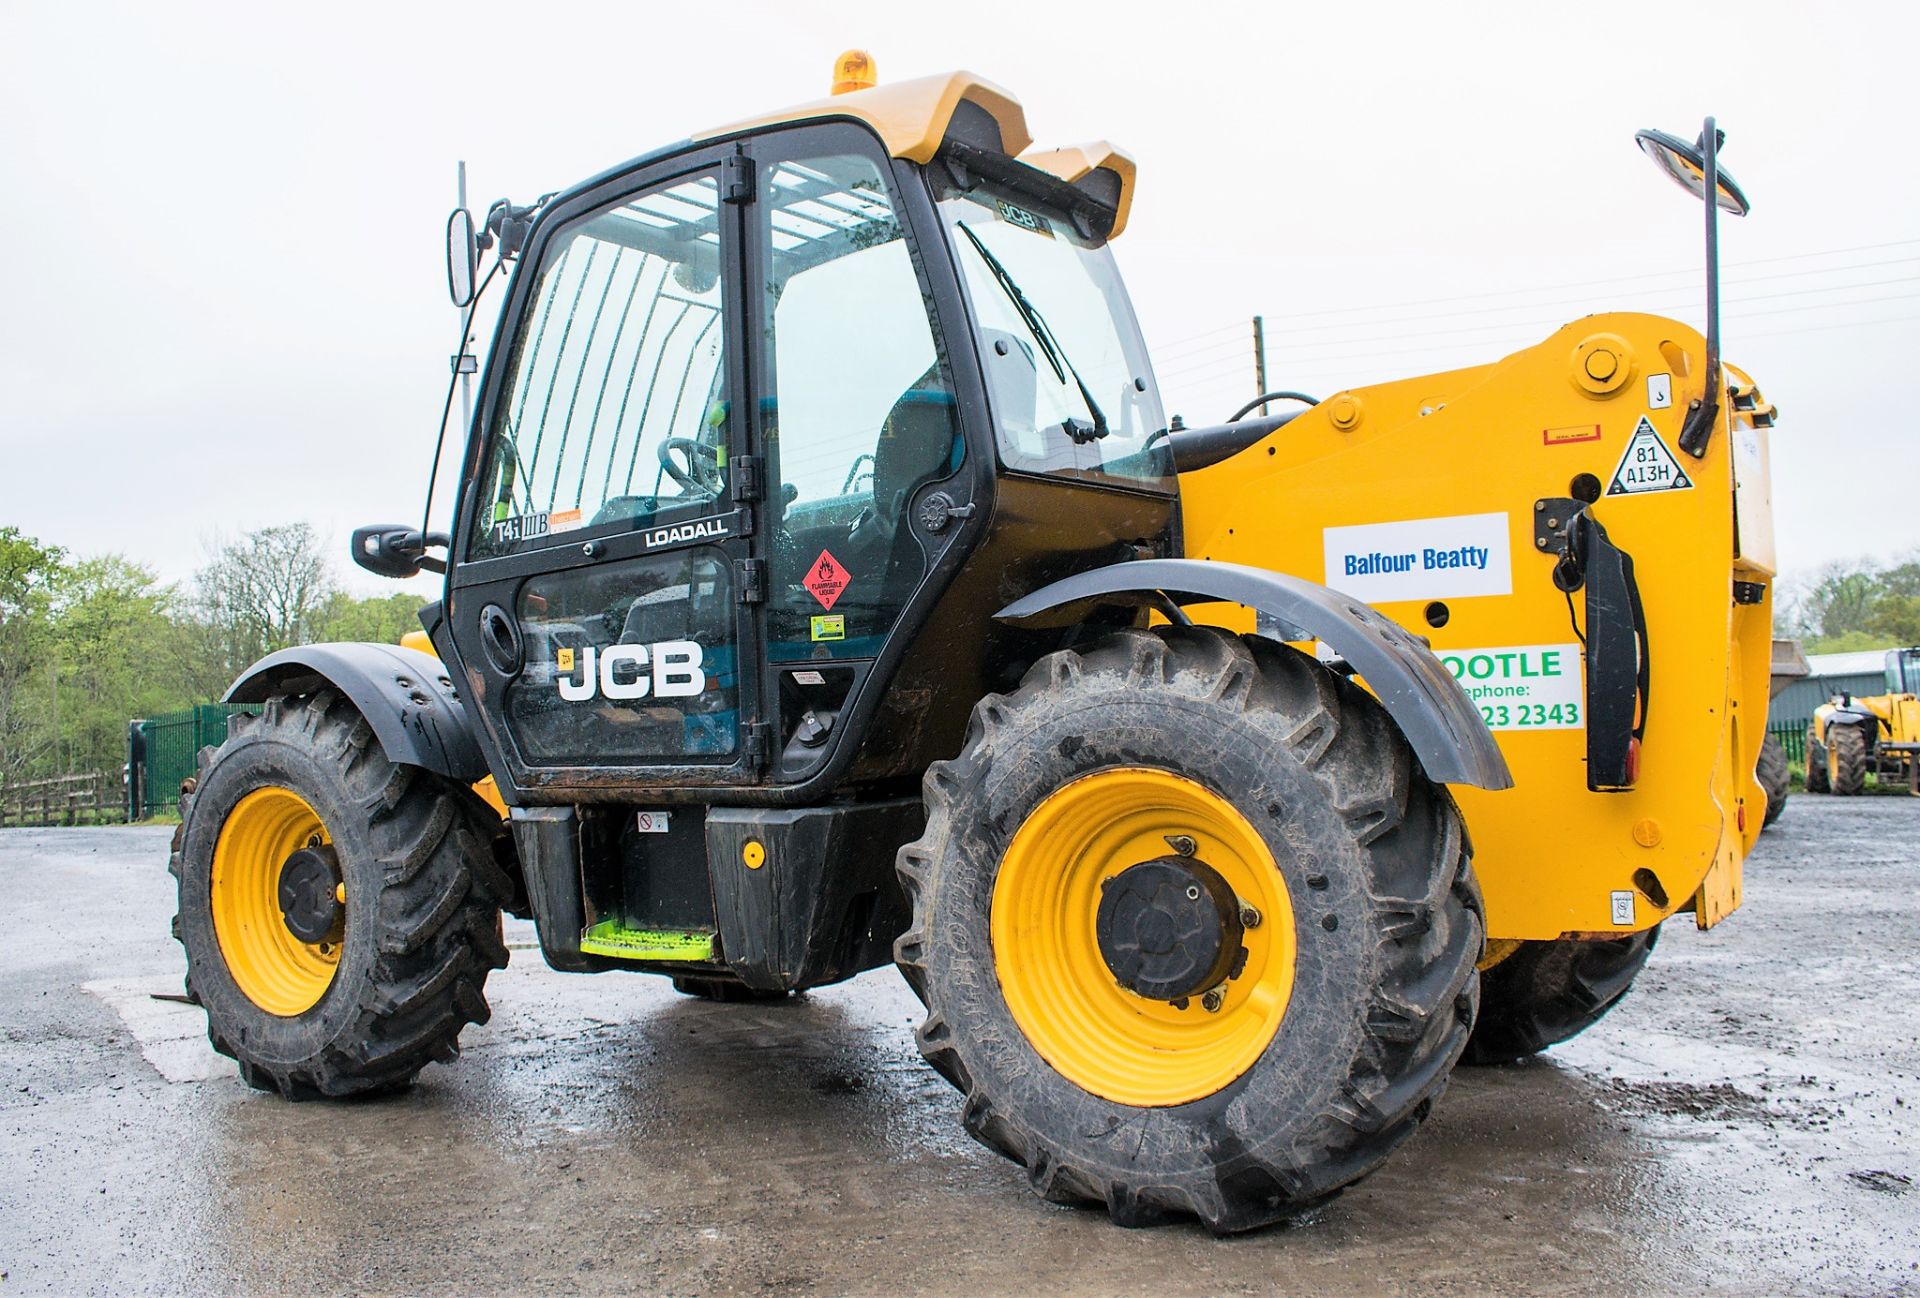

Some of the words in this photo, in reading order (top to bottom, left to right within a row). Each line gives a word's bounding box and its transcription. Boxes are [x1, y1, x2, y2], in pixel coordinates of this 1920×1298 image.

[1001, 203, 1036, 228] JCB
[1637, 446, 1658, 463] 81
[495, 519, 520, 541] T4i
[645, 519, 729, 548] LOADALL
[1344, 552, 1417, 576] Balfour
[1423, 546, 1489, 570] Beatty
[812, 581, 842, 590] FLAMMABLE
[819, 588, 836, 596] LIQUID
[558, 641, 706, 702] JCB
[1517, 703, 1579, 726] 2343
